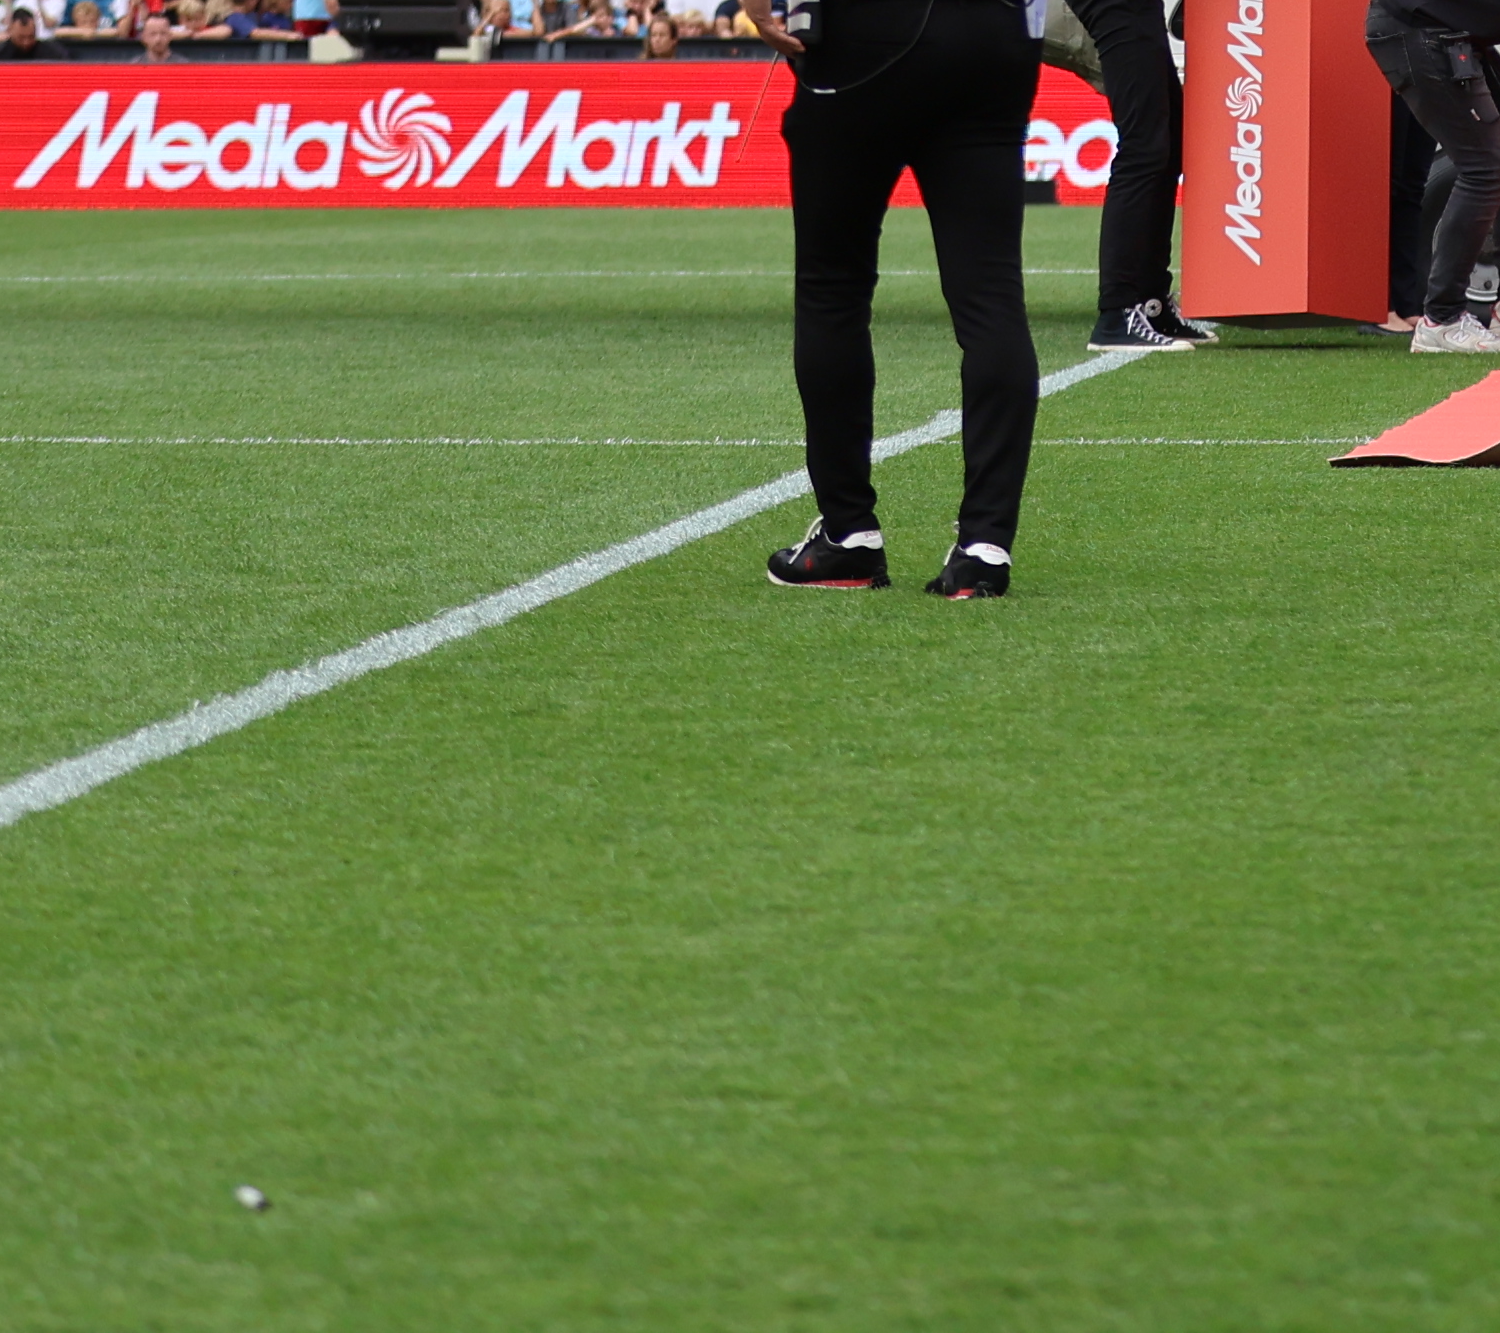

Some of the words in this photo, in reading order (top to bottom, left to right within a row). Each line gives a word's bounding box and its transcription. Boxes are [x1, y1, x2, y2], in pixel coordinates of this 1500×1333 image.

[13, 90, 348, 190] Media
[432, 89, 741, 190] Markt
[1225, 121, 1262, 266] Media
